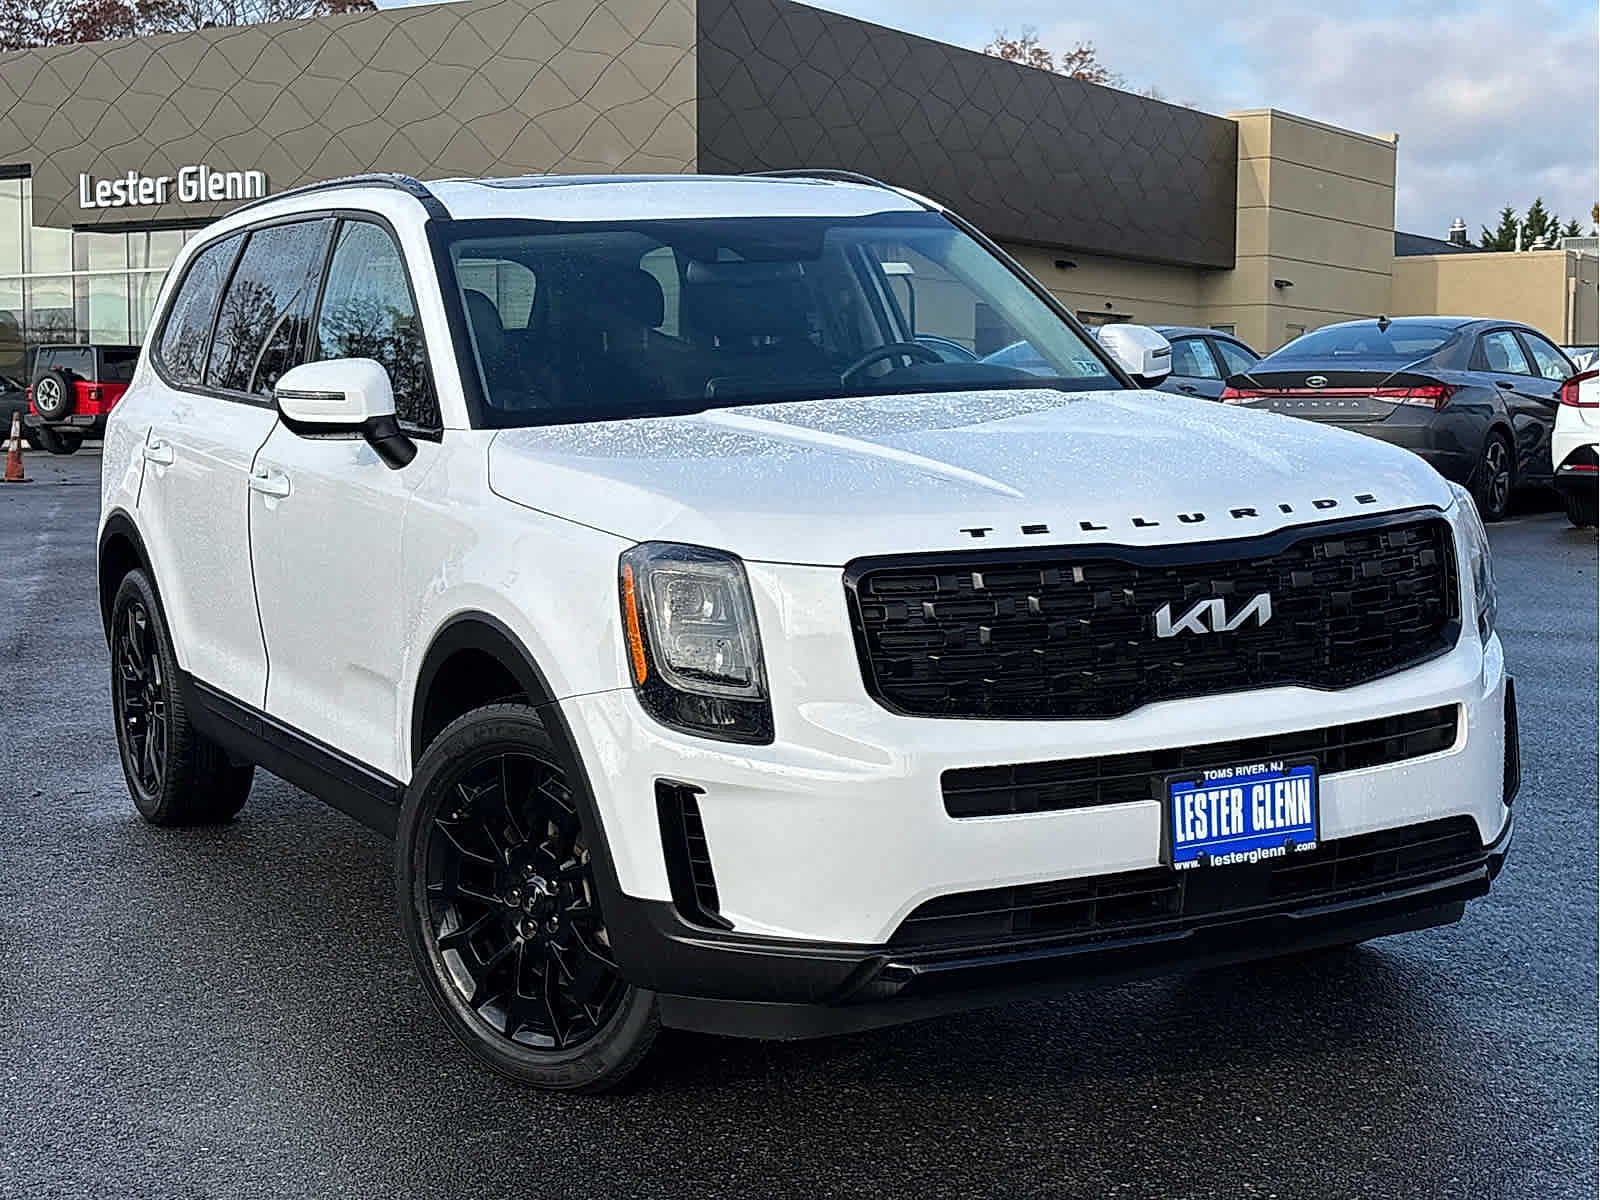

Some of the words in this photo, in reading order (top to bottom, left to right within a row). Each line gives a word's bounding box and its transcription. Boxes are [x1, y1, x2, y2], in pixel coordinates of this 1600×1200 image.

[79, 170, 169, 209] Lester
[178, 165, 266, 202] Glenn
[960, 493, 1378, 539] TELLURIDE
[1203, 768, 1233, 781] TOMS
[1270, 761, 1284, 772] NJ
[1174, 788, 1244, 842] LESTER
[1252, 779, 1312, 832] GLENN
